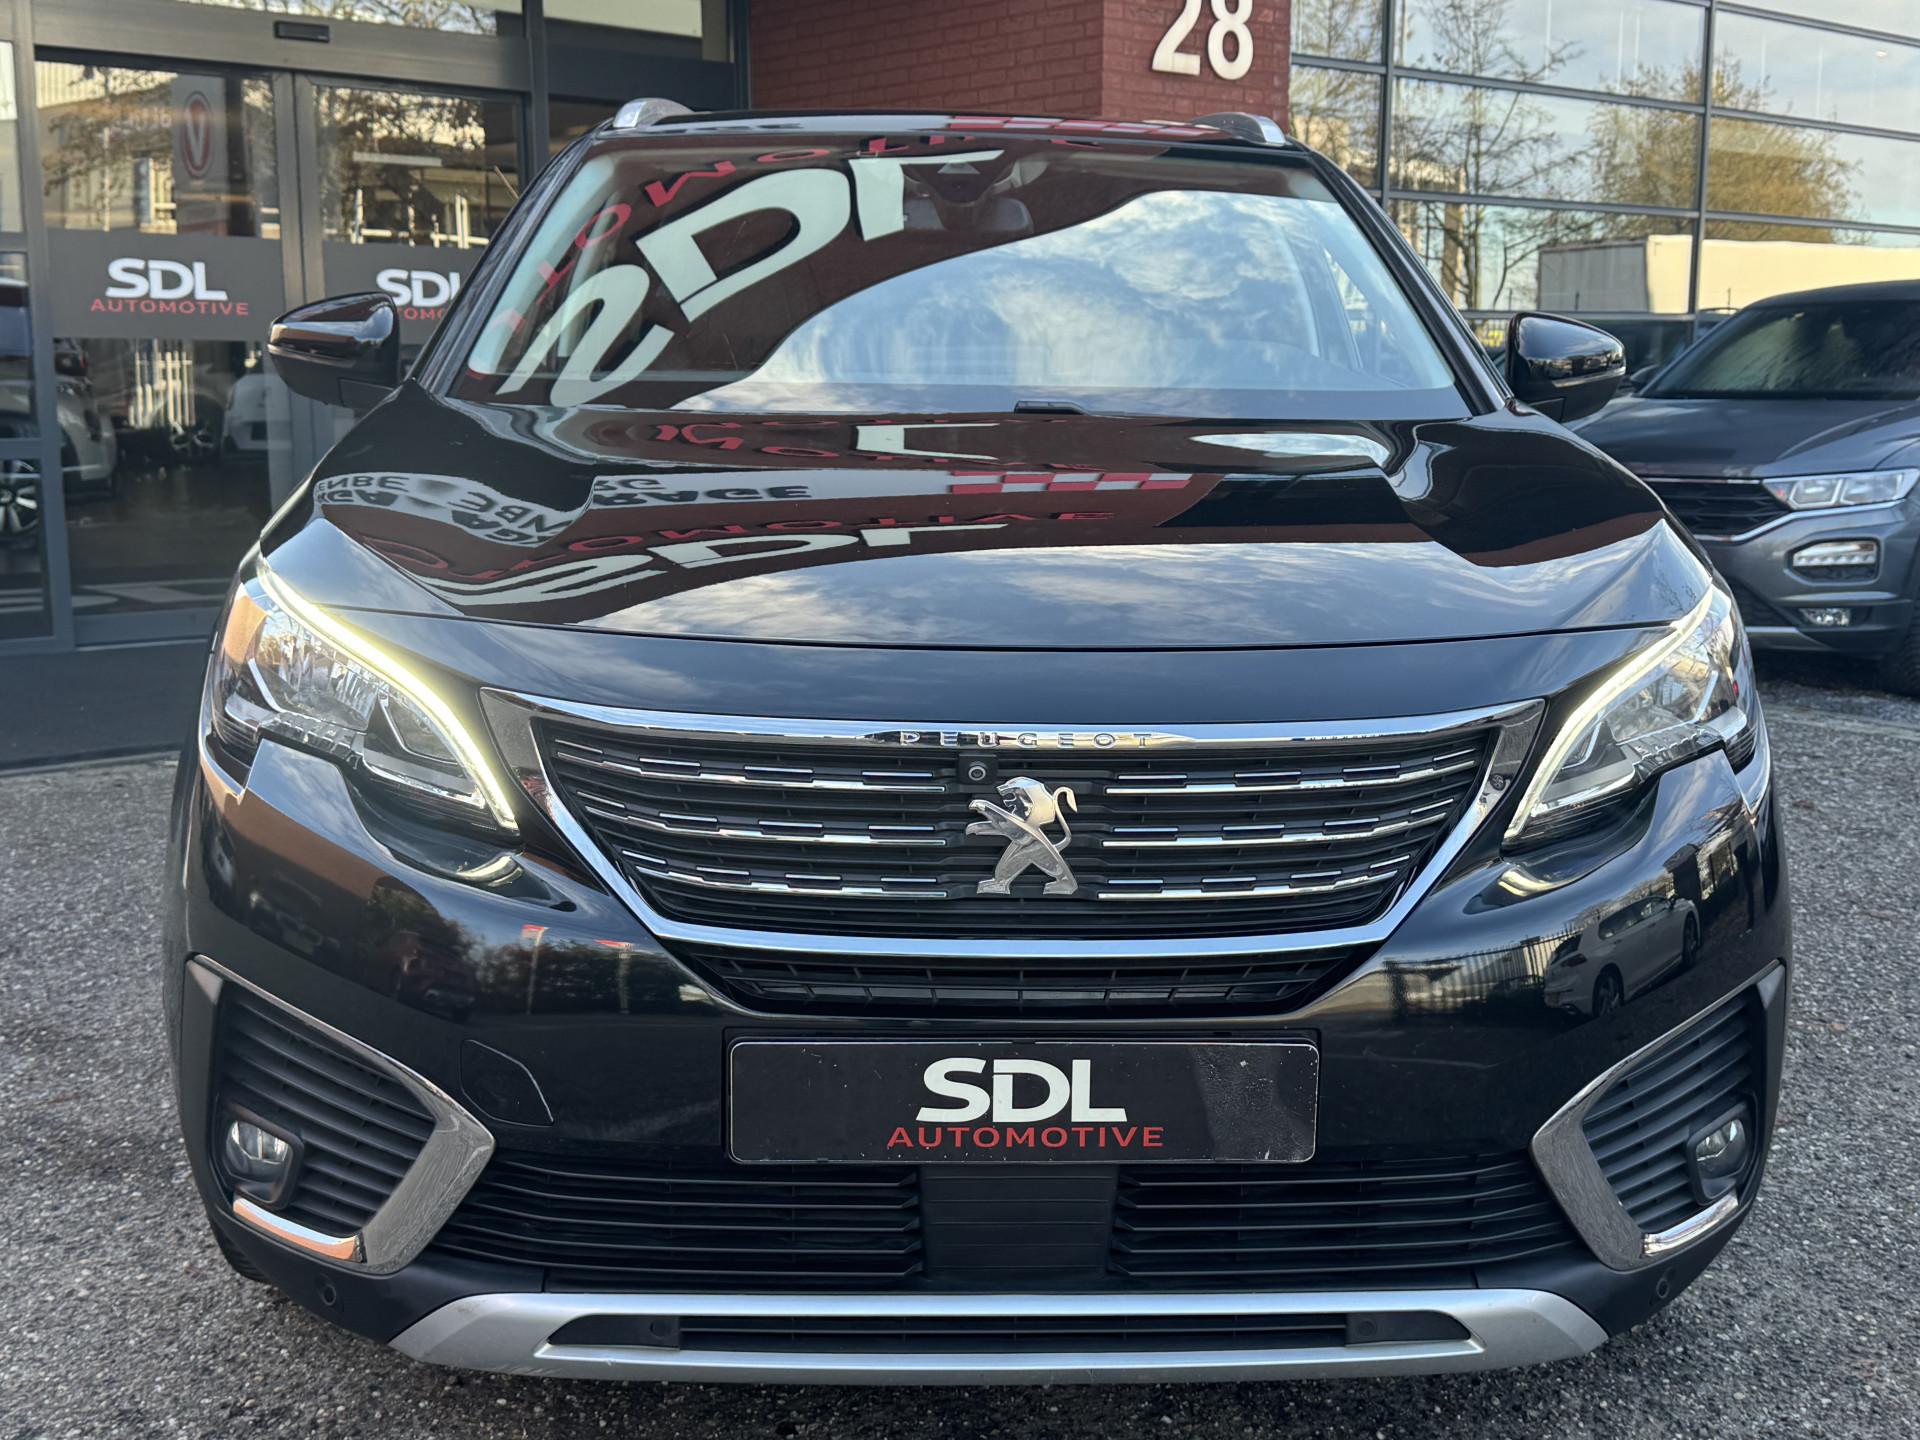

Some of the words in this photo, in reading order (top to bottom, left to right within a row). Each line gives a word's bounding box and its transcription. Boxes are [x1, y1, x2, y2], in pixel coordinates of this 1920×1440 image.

[1151, 0, 1254, 81] 28
[105, 257, 228, 301] SDL
[91, 298, 249, 316] AUTOMOTIVE
[899, 731, 1153, 749] PEUGEOT
[915, 1057, 1128, 1123] SDL
[886, 1126, 1164, 1148] AUTOMOTIVE
